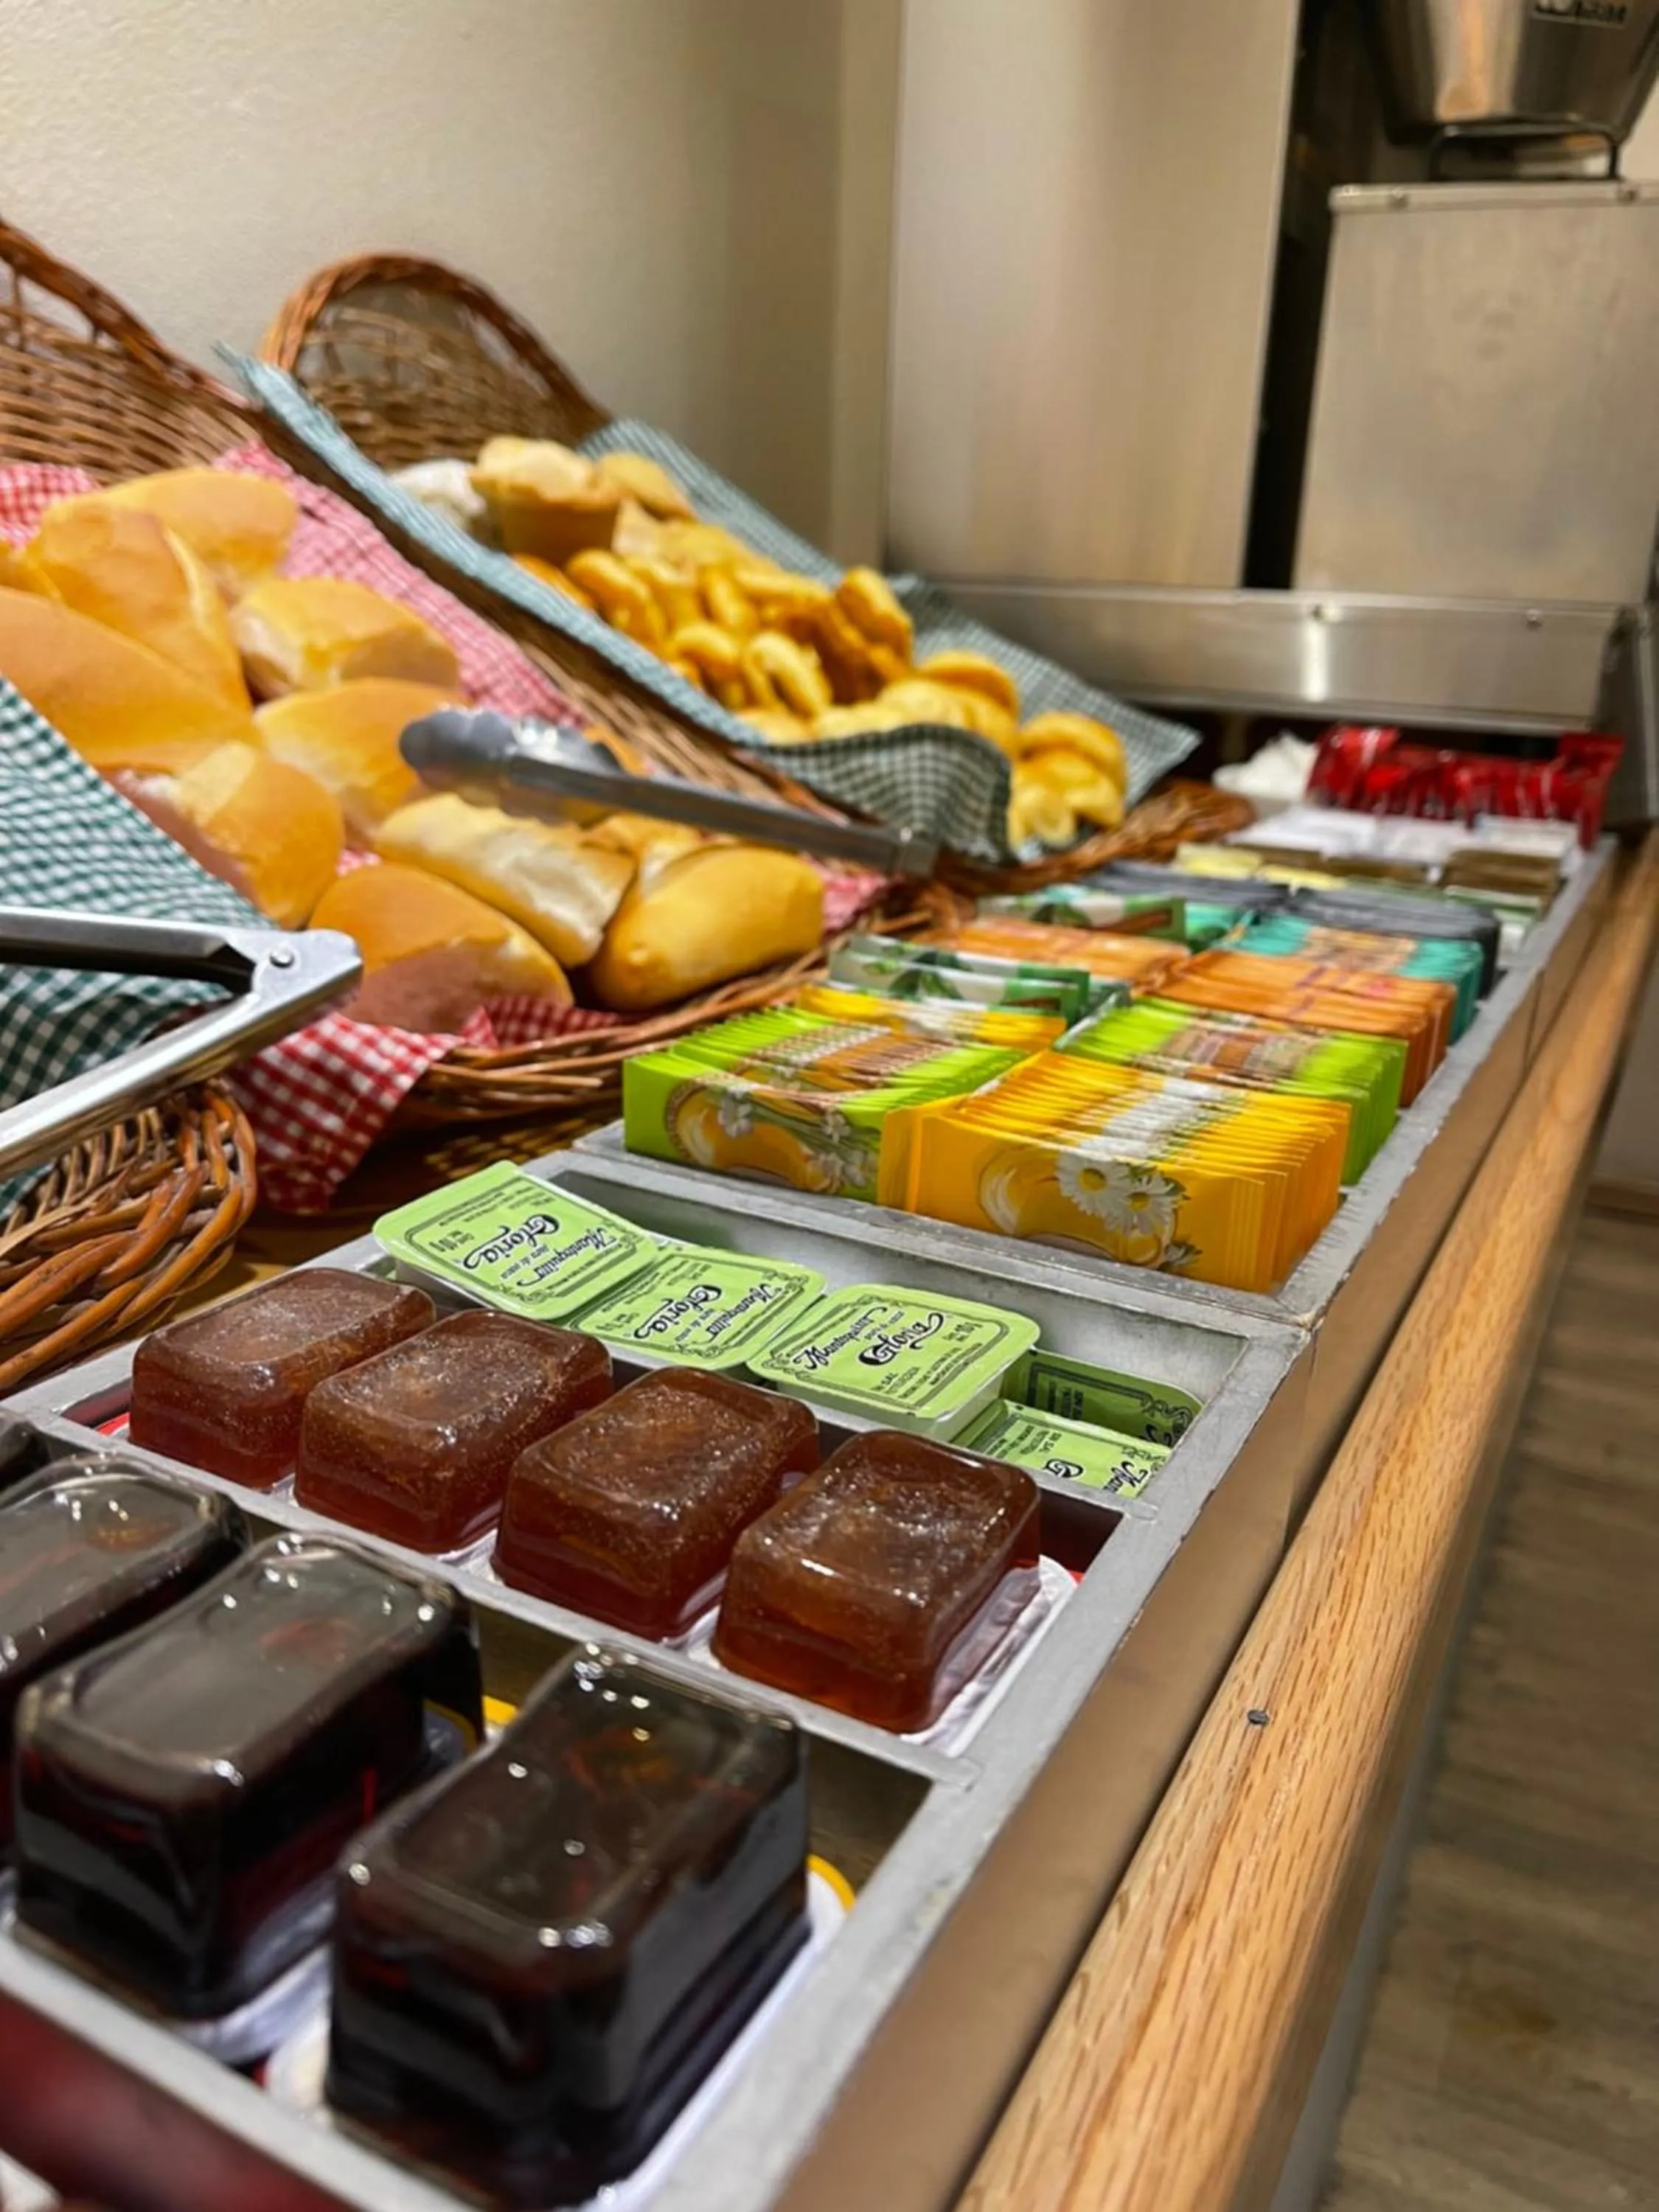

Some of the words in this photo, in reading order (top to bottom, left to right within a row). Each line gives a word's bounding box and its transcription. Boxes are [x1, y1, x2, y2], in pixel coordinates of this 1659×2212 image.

[463, 1214, 560, 1270] Gloria
[517, 1227, 616, 1286] Mantequilla
[634, 1284, 722, 1339] Gloria
[859, 1312, 944, 1366] Gloria
